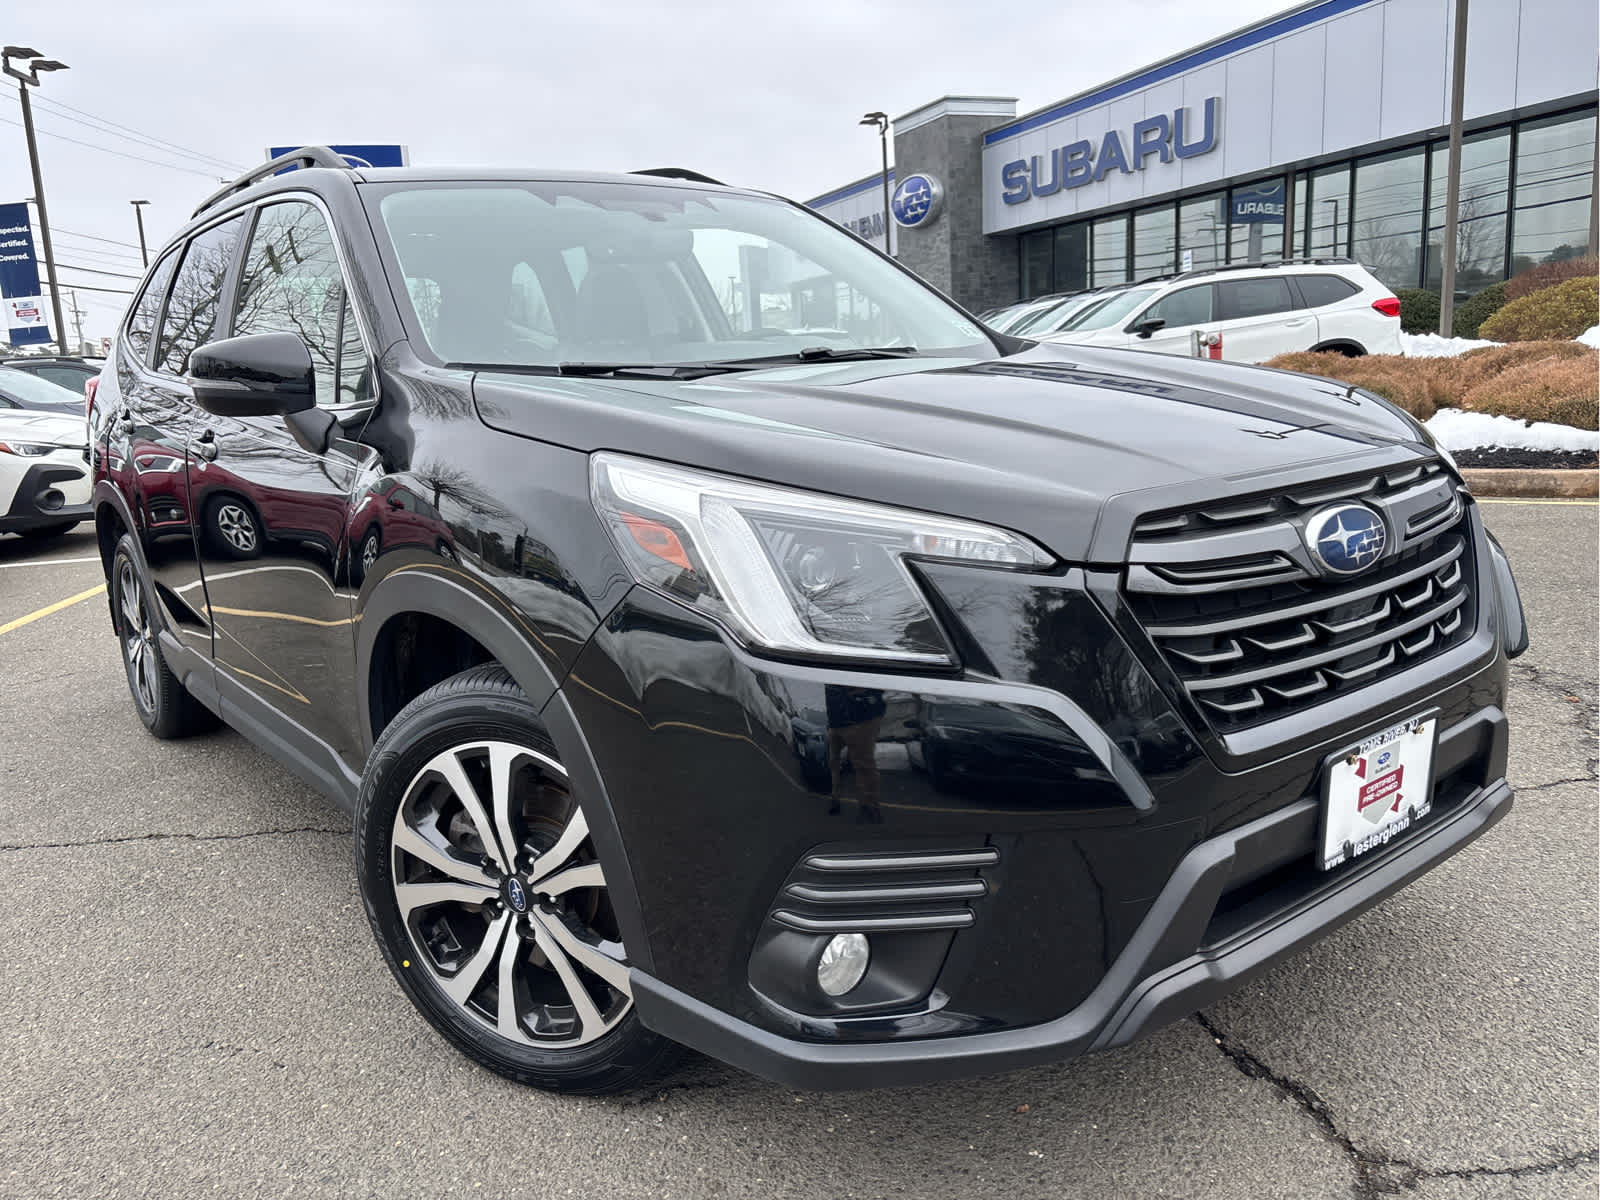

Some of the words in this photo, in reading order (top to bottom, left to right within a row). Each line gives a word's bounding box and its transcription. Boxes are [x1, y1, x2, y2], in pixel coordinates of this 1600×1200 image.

[1002, 96, 1220, 205] SUBARU
[0, 239, 29, 249] ertified.
[1366, 774, 1397, 794] CERTIFIED
